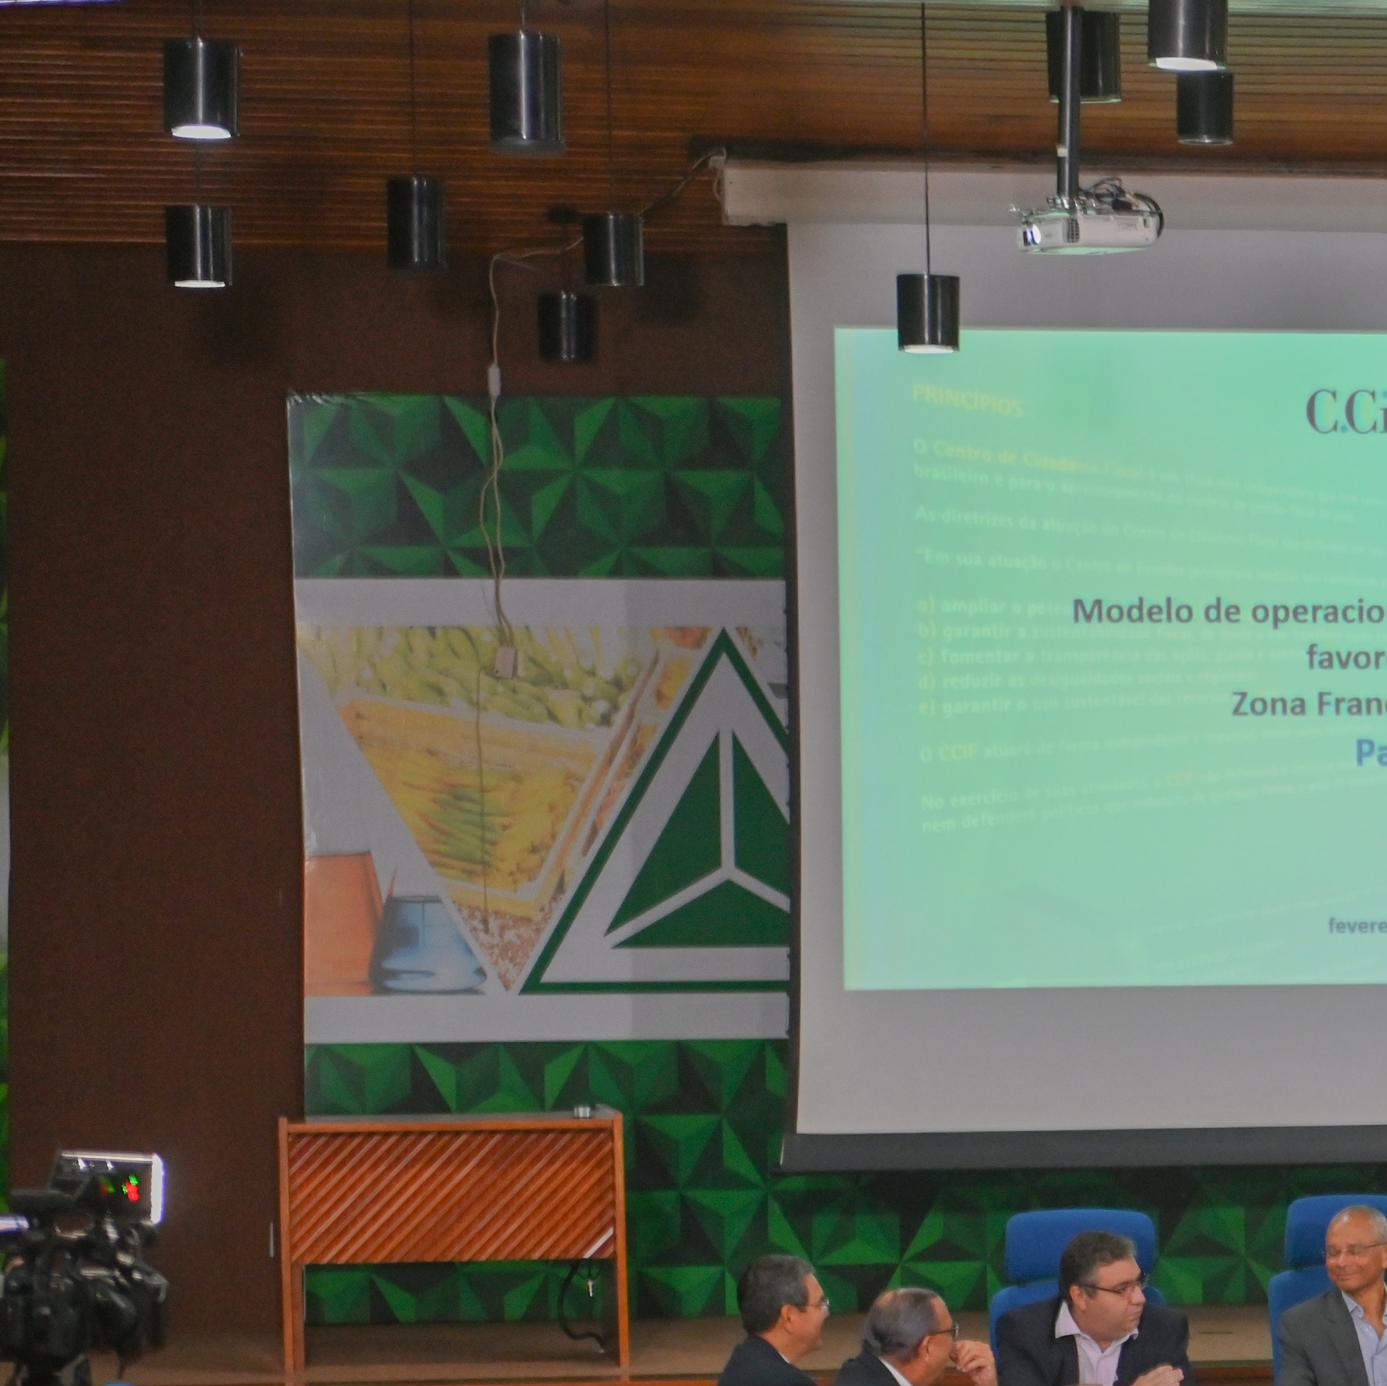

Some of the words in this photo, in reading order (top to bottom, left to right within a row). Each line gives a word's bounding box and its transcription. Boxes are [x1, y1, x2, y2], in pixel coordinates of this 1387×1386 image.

[1072, 597, 1194, 624] Modelo
[1203, 597, 1242, 624] de
[1232, 691, 1307, 717] Zona
